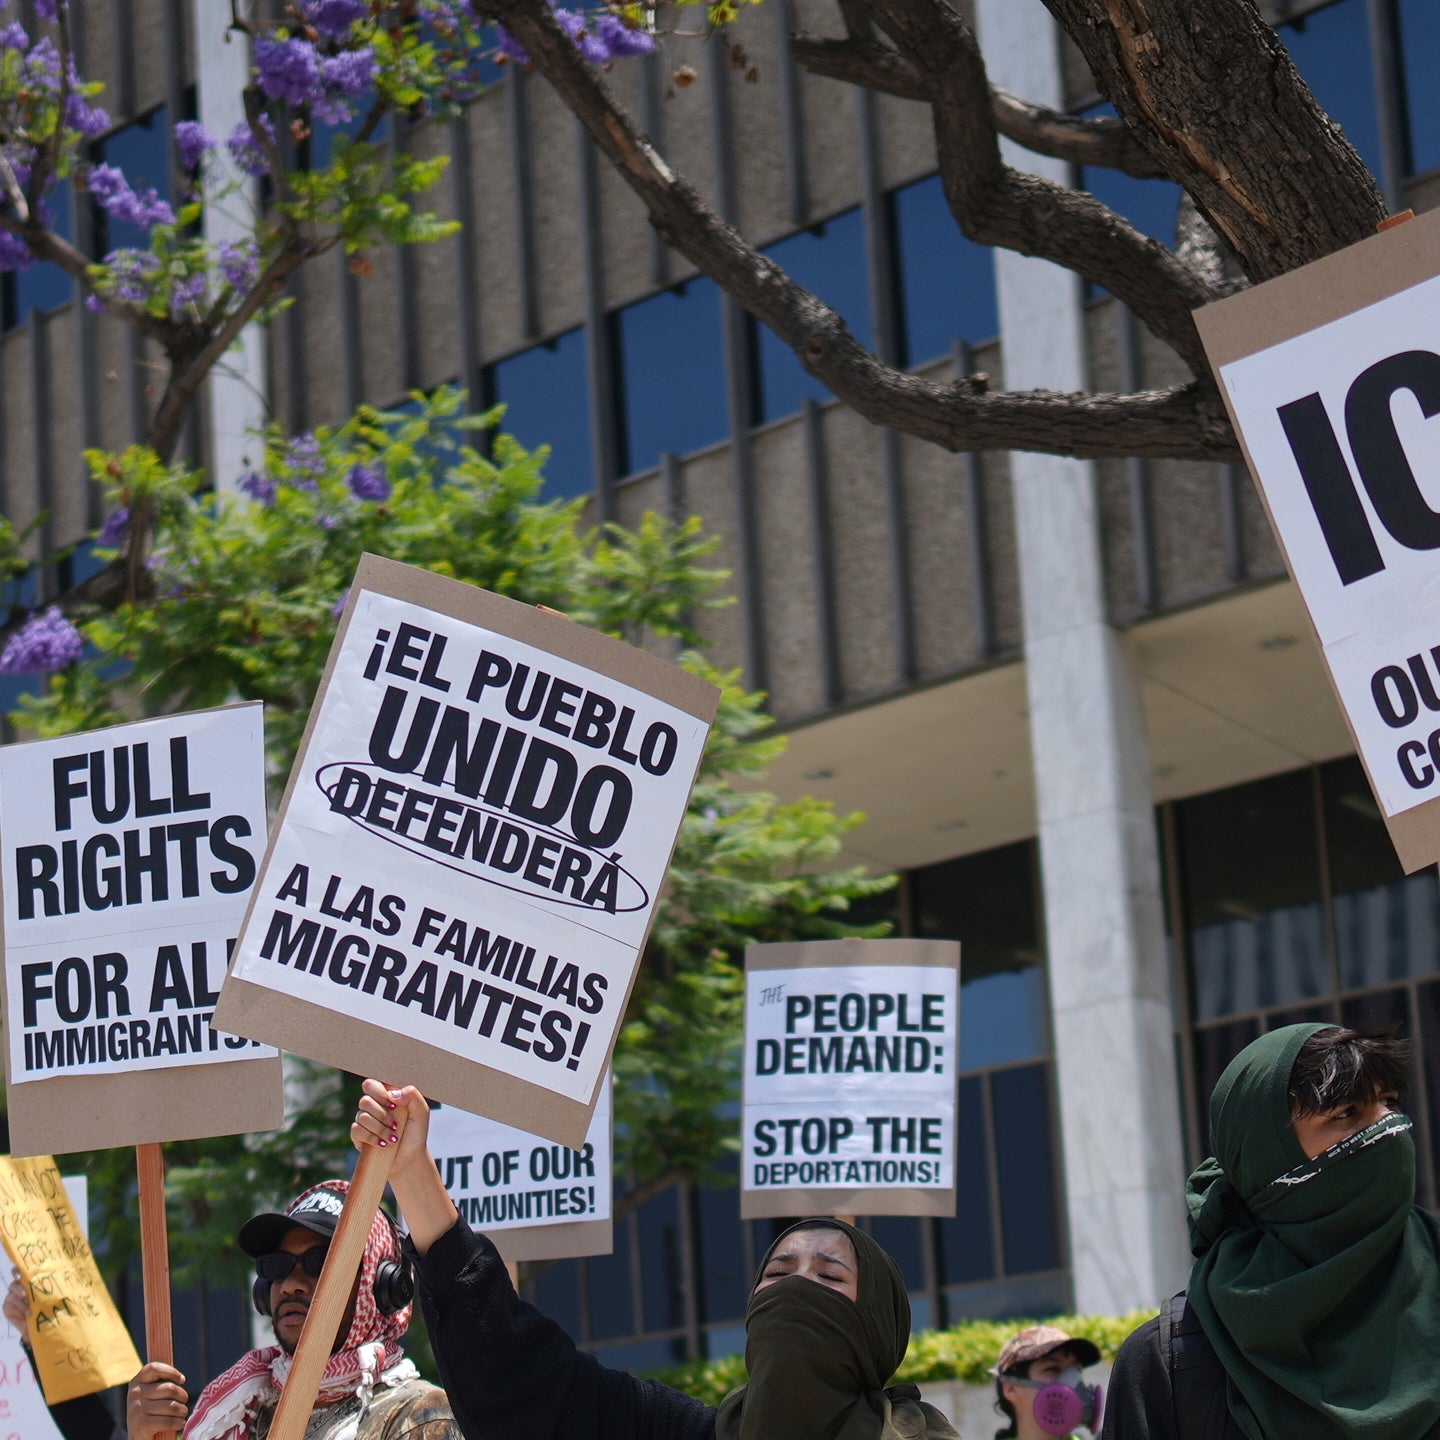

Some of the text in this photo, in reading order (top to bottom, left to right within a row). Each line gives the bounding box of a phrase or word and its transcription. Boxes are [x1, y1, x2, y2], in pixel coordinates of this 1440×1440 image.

[363, 620, 679, 777] ¡EL PUEBLO
[52, 736, 211, 831] FULL
[367, 688, 633, 849] UNIDO
[16, 814, 256, 920] RIGHTS
[328, 765, 621, 915] DEFENDERÁ
[275, 863, 609, 1016] A LAS FAMILIAS
[21, 952, 130, 1029] FOR
[260, 910, 593, 1072] MIGRANTES!
[759, 983, 945, 1034] THE PEOPLE
[756, 1036, 944, 1076] DEMAND:
[434, 1142, 596, 1190] UT OF OUR
[753, 1117, 942, 1157] STOP THE
[754, 1160, 940, 1186] DEPORTATIONS!
[1350, 1132, 1365, 1144] MEET
